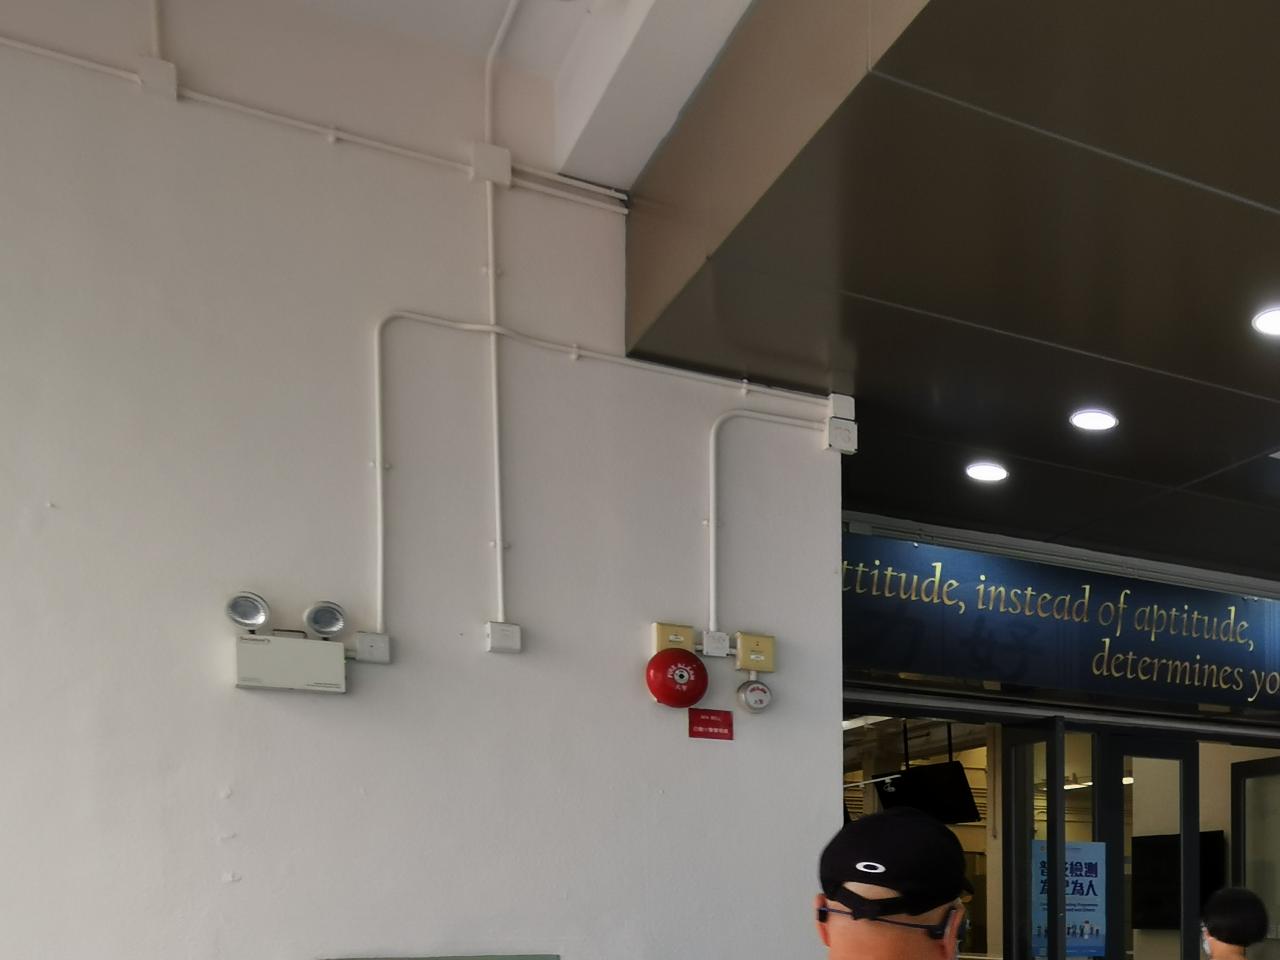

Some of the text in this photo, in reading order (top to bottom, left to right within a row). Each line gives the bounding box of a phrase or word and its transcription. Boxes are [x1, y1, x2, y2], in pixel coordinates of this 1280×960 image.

[976, 574, 1091, 623] instead
[1099, 589, 1132, 637] of
[1134, 603, 1255, 652] aptitude,
[1091, 638, 1244, 692] determines
[1040, 860, 1099, 878] 普檢測
